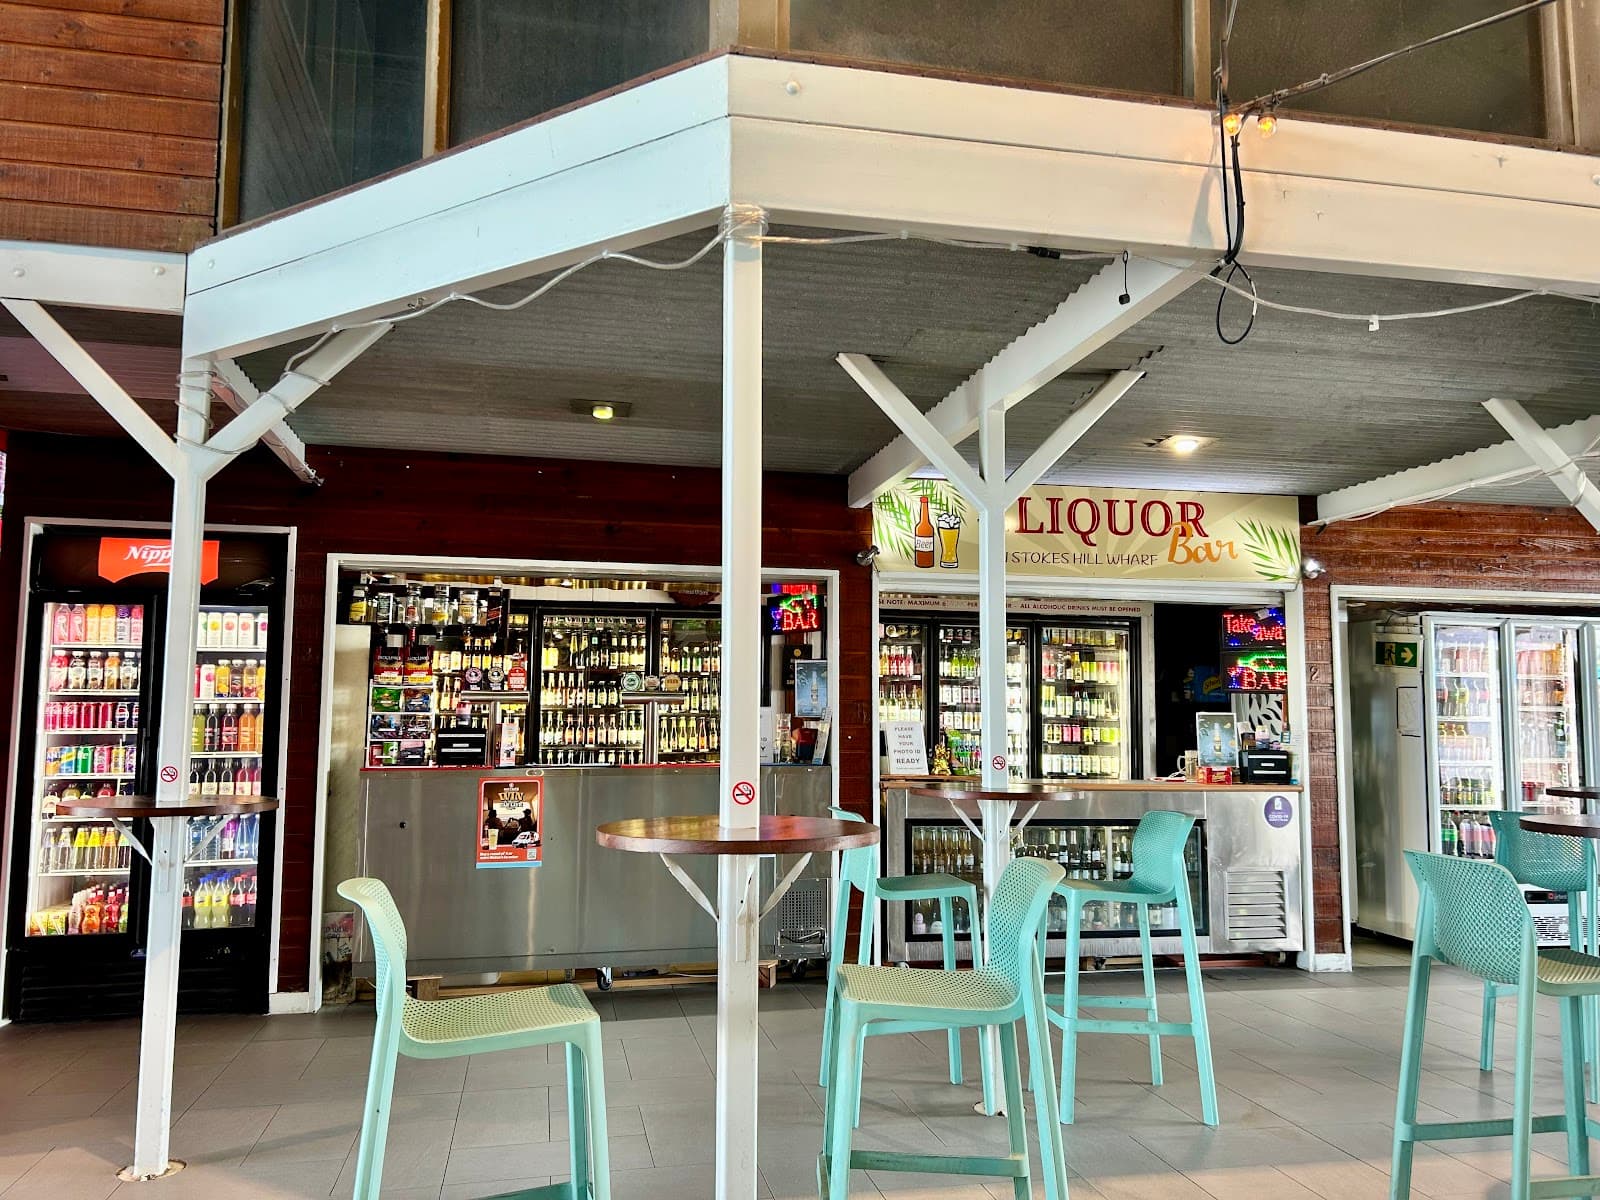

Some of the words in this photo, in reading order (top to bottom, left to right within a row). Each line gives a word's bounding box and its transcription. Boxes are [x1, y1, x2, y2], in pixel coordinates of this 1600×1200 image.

[1015, 496, 1209, 547] LIQUOR
[915, 538, 933, 550] Beer
[1167, 521, 1239, 565] Bar
[123, 545, 172, 567] Nipp
[1012, 551, 1070, 565] STOKES
[1073, 552, 1104, 565] HILL
[1106, 553, 1159, 566] WHARF
[782, 610, 818, 631] BAR
[1223, 613, 1257, 634] Take
[1254, 626, 1286, 641] awa
